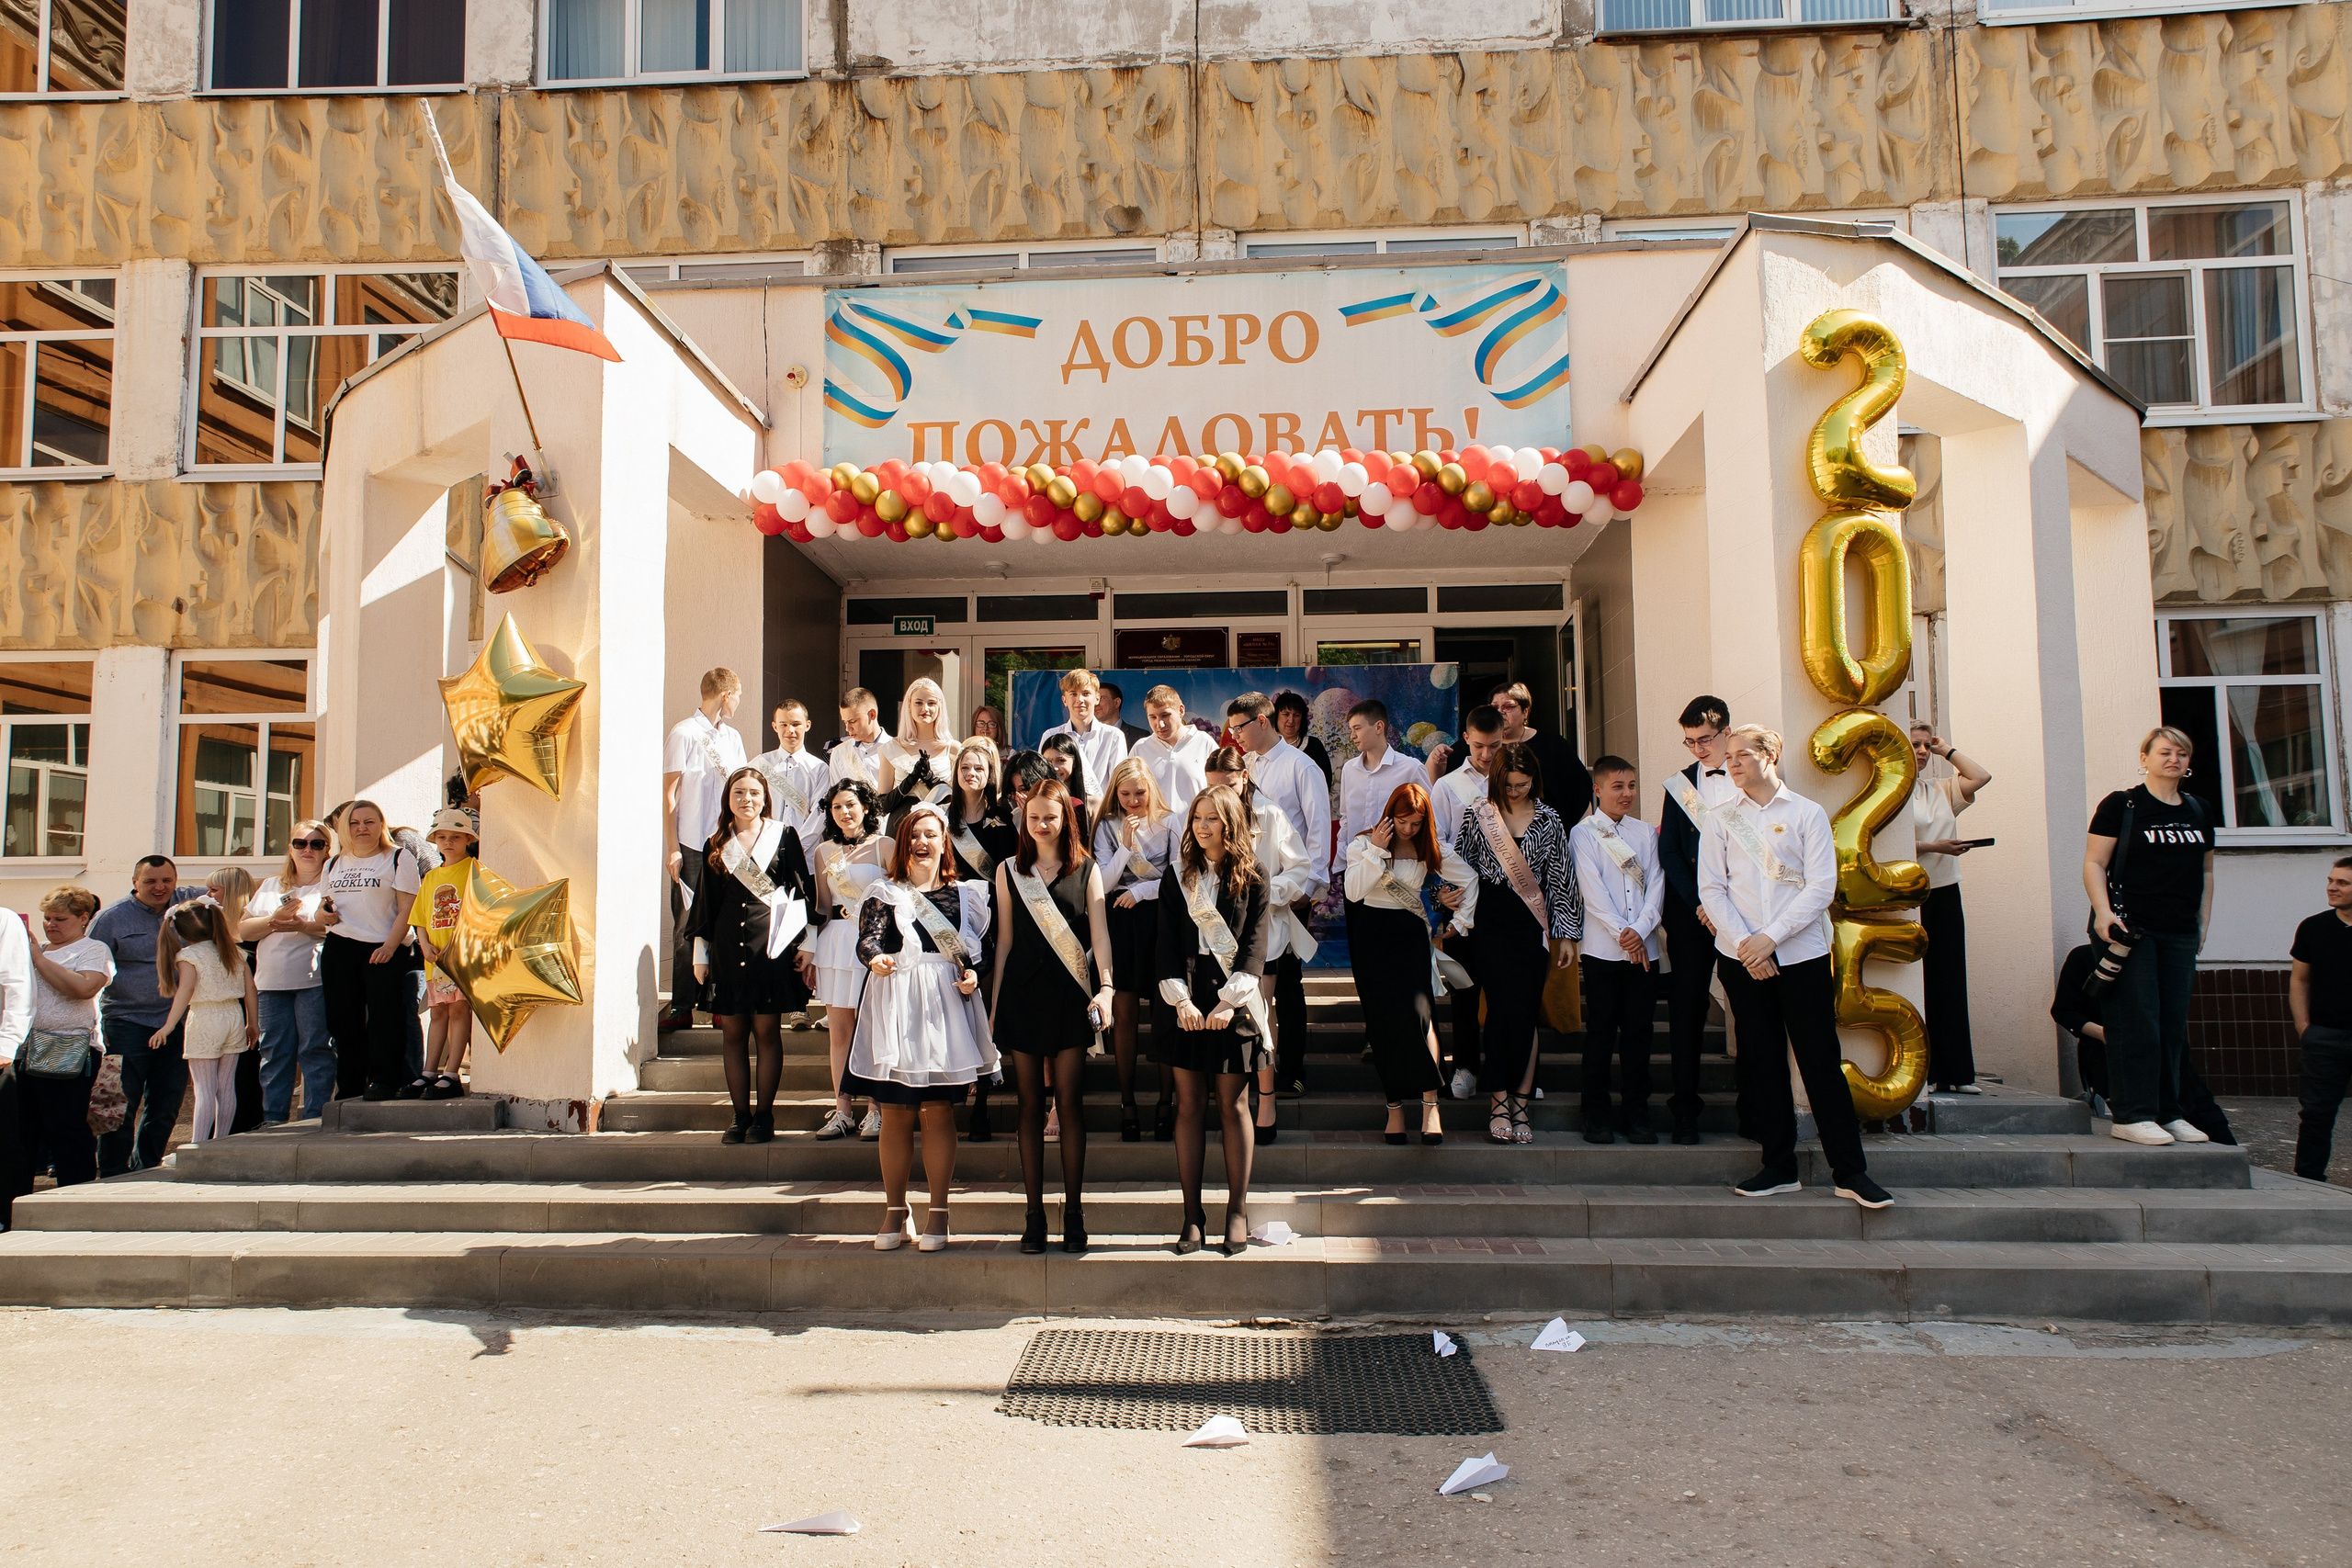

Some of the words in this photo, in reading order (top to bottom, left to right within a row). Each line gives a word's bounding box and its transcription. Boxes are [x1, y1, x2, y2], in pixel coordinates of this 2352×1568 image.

[1060, 310, 1319, 385] ДОБРО
[906, 407, 1480, 470] ПОЖАЛОВАТЬ!
[899, 620, 929, 634] ВХОД
[1486, 820, 1530, 889] Выпускница
[2143, 829, 2205, 843] VISION
[328, 878, 381, 889] ROOKLYN
